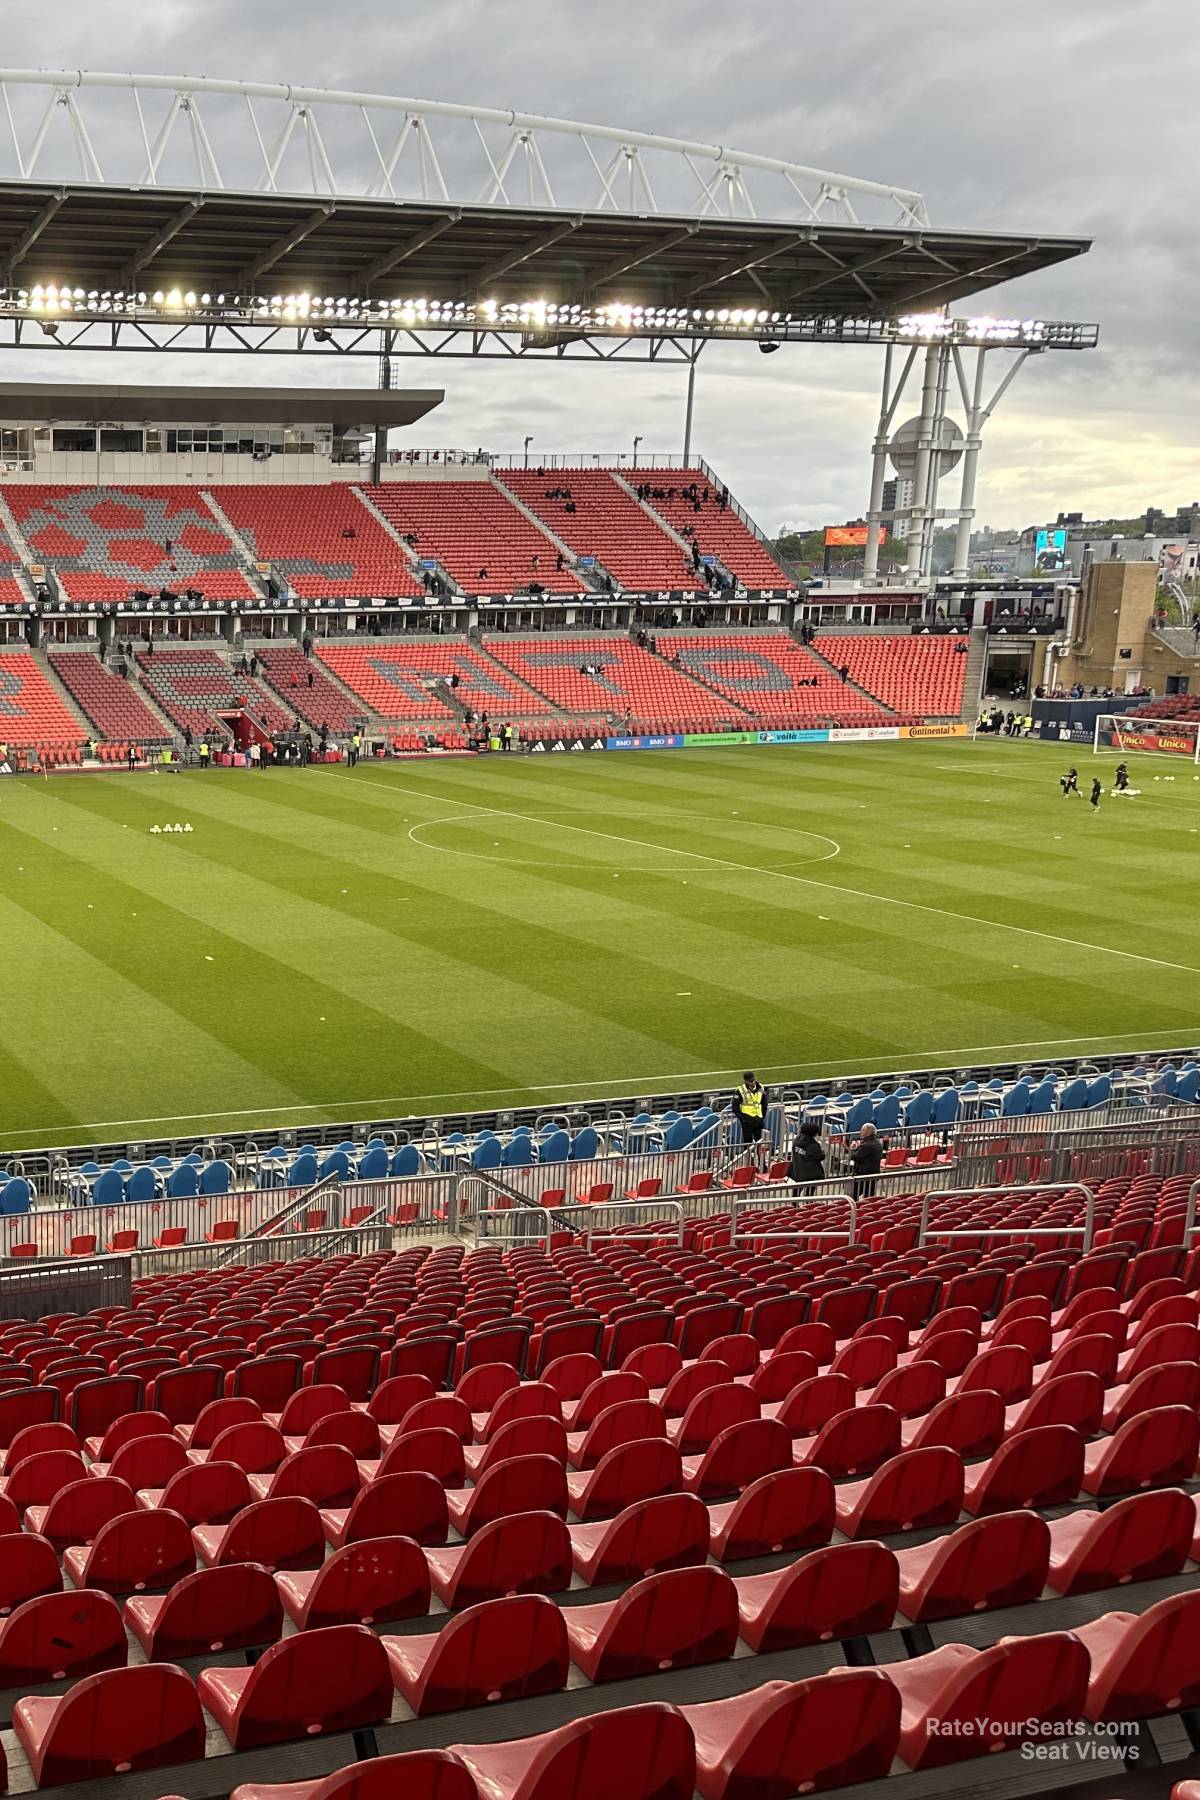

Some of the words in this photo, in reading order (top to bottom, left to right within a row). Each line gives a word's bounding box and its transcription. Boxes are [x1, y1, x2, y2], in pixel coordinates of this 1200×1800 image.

[658, 592, 670, 600] Bell
[682, 591, 695, 600] Bell
[709, 591, 721, 599] Bell
[735, 590, 747, 599] Bell
[760, 590, 773, 599] Bell
[787, 590, 799, 599] Bell
[909, 727, 950, 737] Continental
[1158, 738, 1186, 749] Unico
